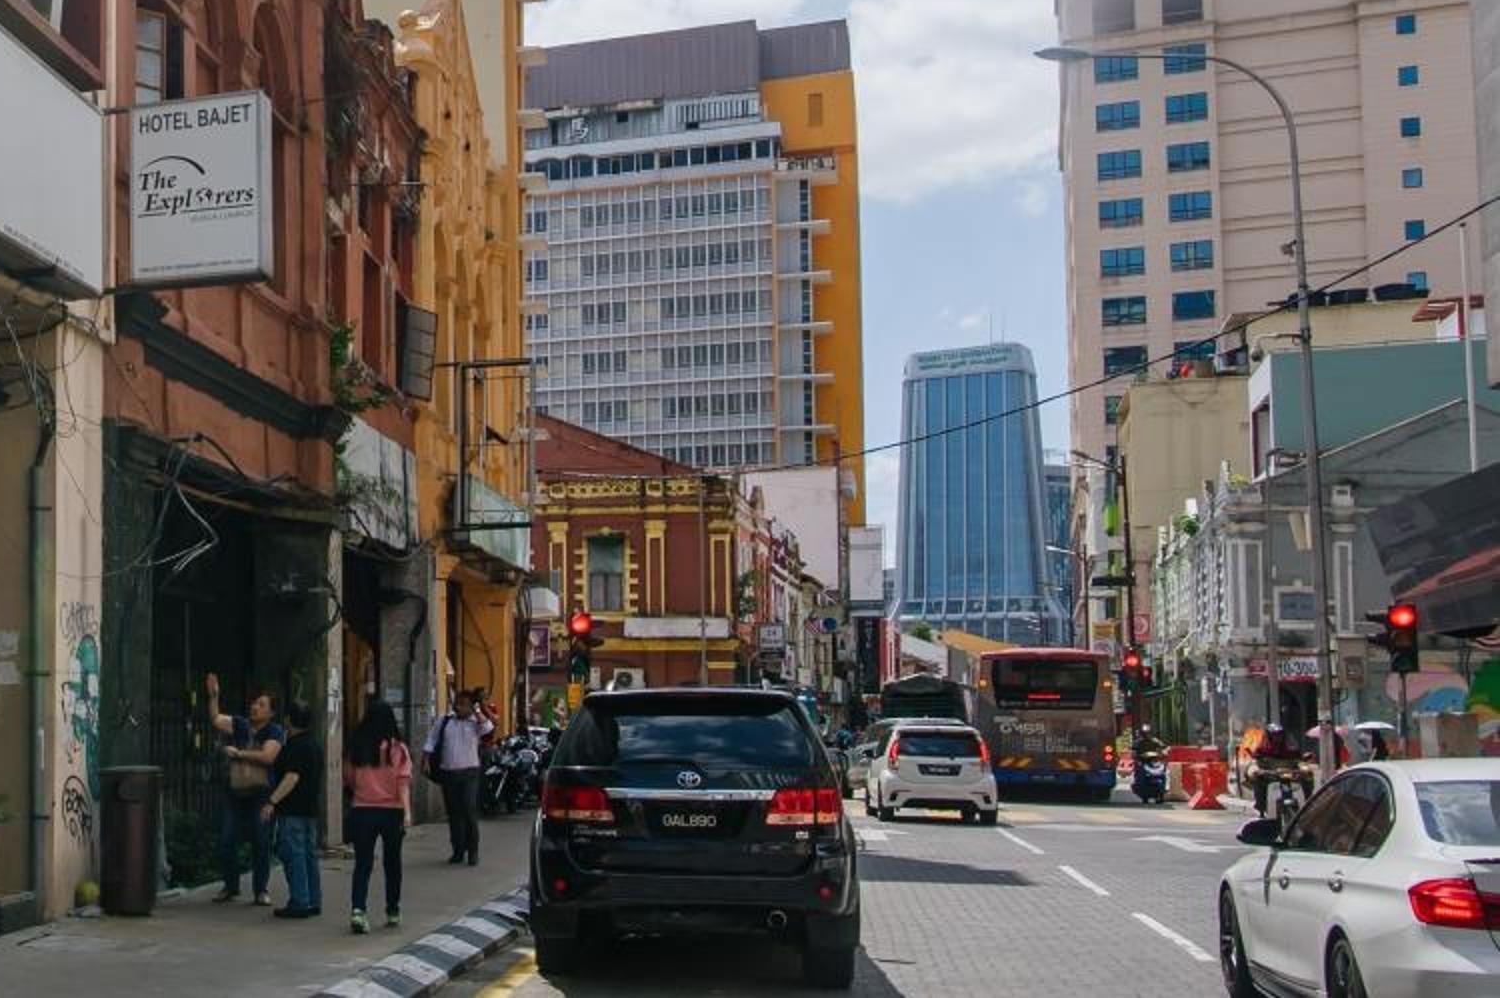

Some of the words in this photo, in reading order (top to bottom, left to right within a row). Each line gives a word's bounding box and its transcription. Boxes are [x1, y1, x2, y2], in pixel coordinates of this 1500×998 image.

[139, 111, 192, 134] HOTEL
[197, 103, 252, 127] BAJET
[138, 171, 178, 192] The
